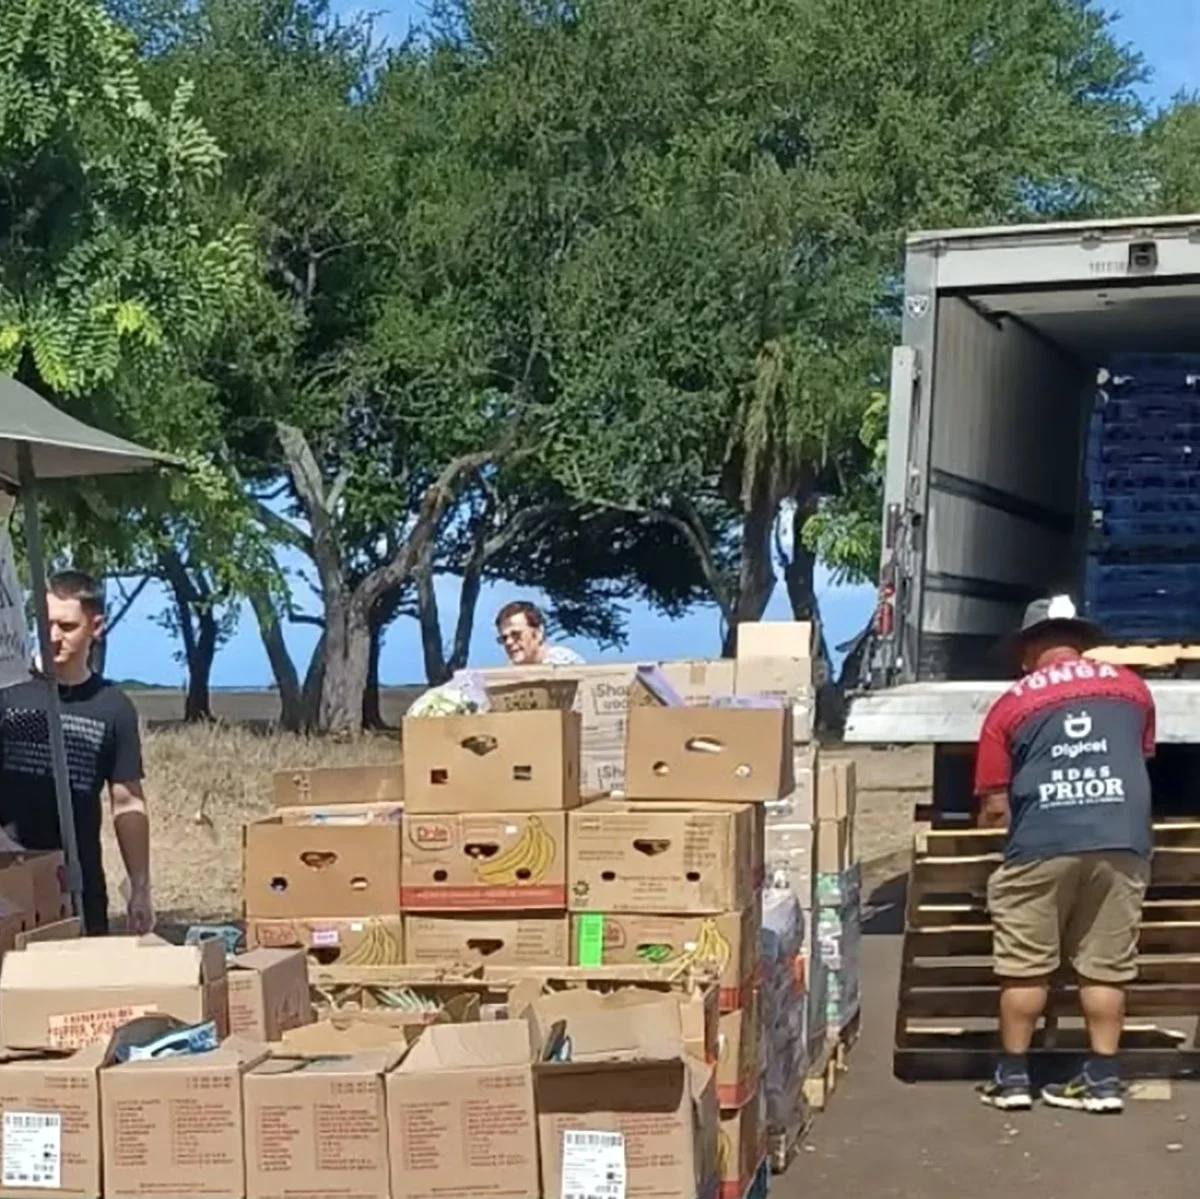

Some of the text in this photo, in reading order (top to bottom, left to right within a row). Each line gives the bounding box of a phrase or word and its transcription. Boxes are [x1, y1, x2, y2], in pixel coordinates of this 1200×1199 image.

[1010, 661, 1118, 695] TONGA
[1052, 738, 1108, 758] Digicel
[1039, 778, 1125, 803] PRIOR
[416, 824, 448, 842] Dole
